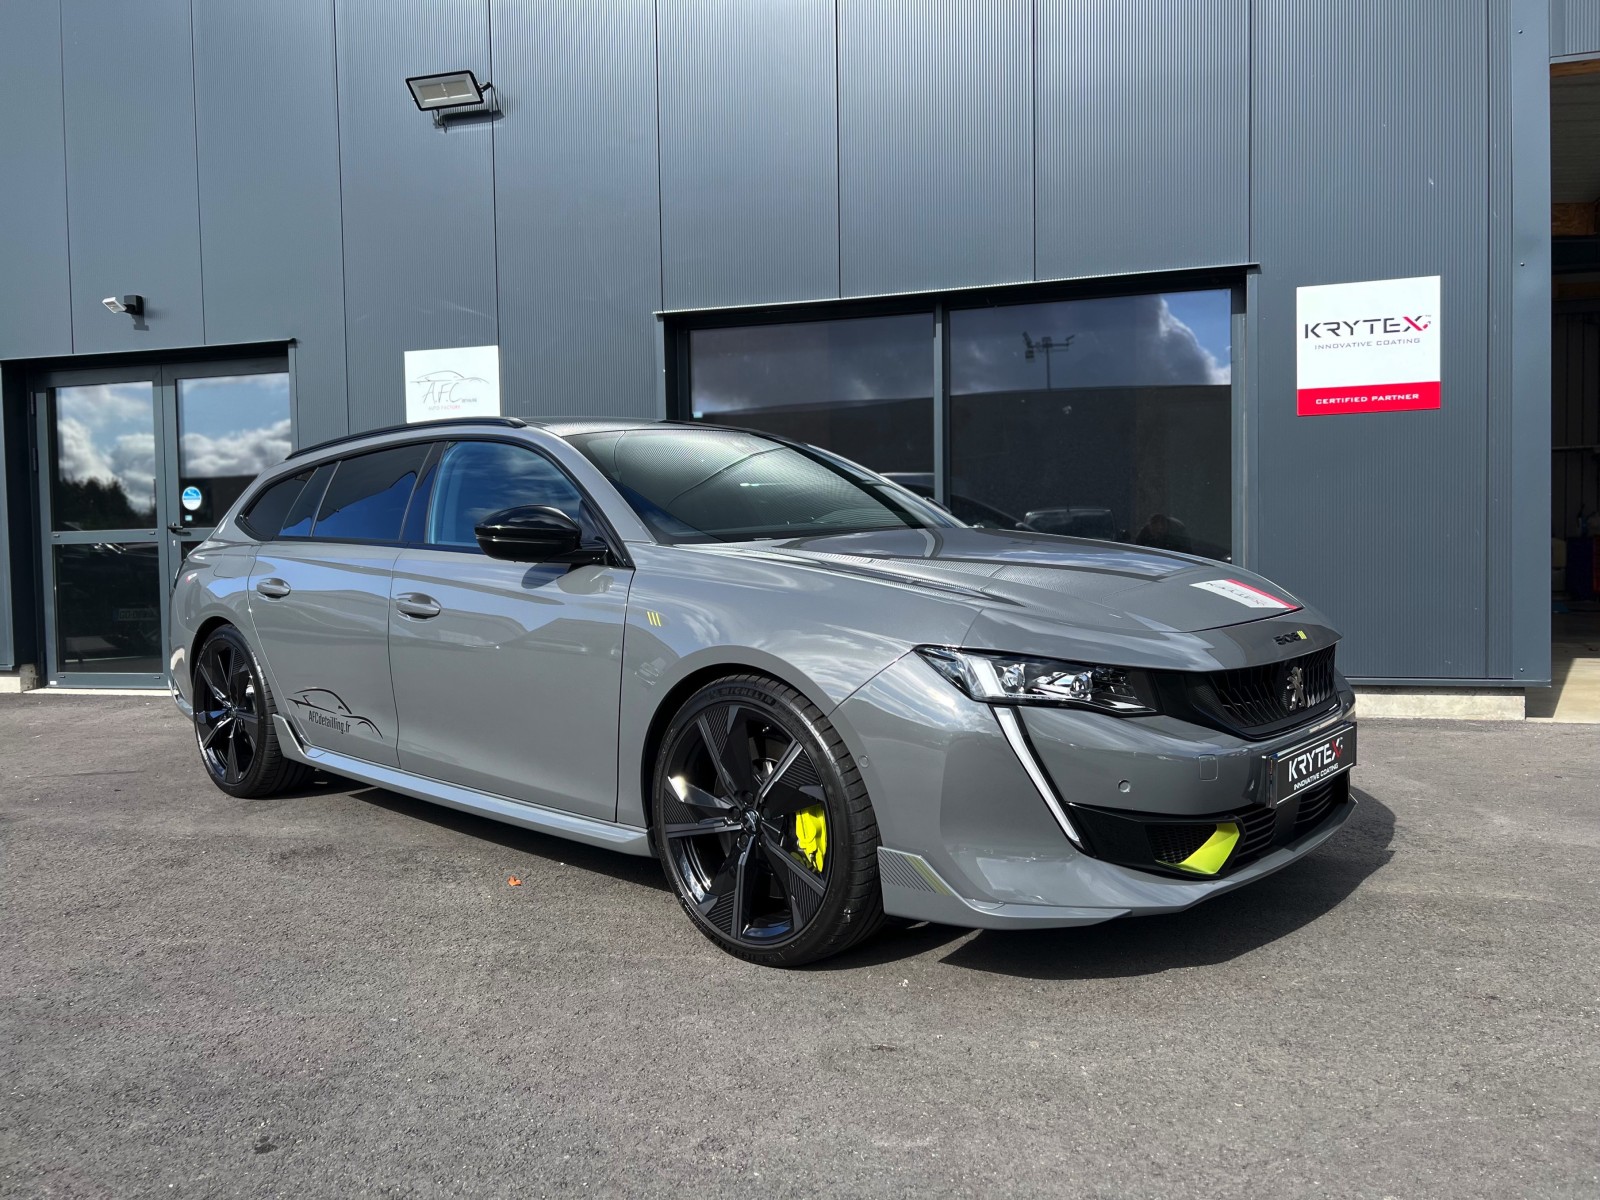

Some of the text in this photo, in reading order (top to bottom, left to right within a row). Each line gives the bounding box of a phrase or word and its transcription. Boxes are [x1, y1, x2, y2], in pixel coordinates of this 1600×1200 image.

[1305, 315, 1430, 339] KRYTEX
[1314, 338, 1421, 350] INNOVATIVE COATING
[1315, 393, 1420, 405] CERTIFIED PARTNER
[1288, 737, 1344, 782] KRYTEX
[1293, 762, 1339, 790] INNOVATIVE COATING
